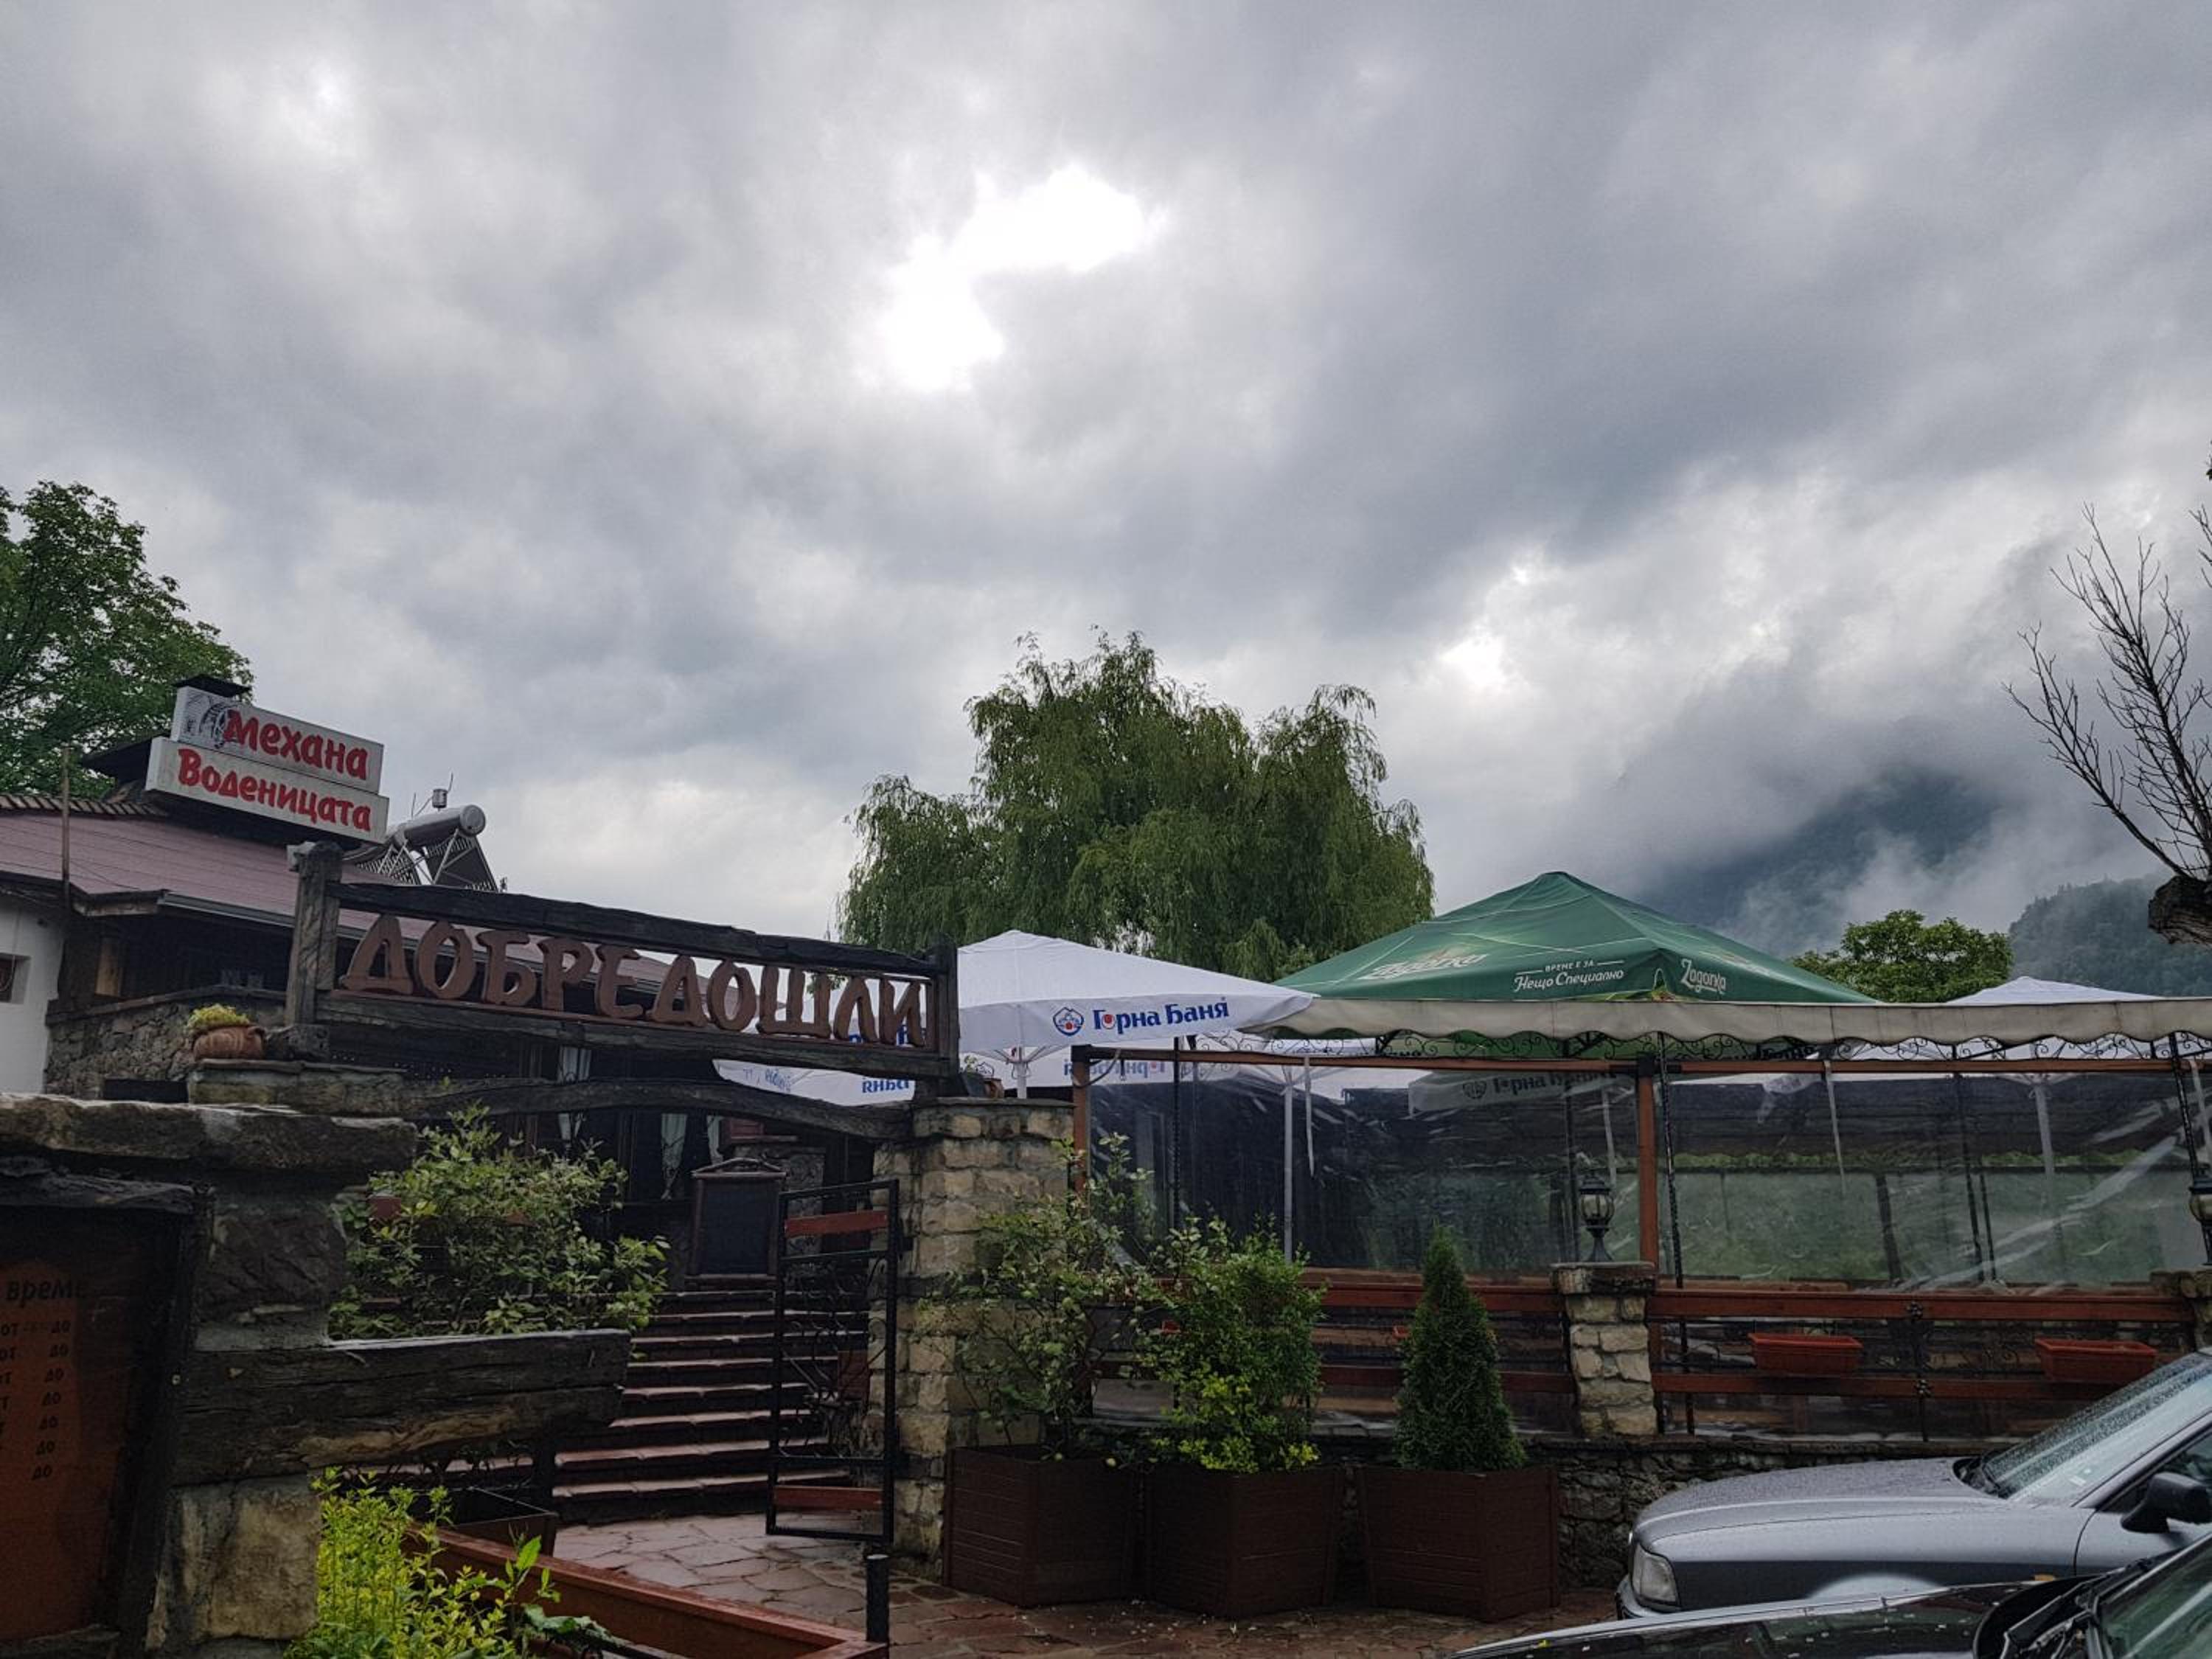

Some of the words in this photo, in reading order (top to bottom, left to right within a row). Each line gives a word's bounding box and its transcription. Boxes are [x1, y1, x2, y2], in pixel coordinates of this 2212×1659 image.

[224, 709, 368, 780] Механа
[177, 748, 371, 832] Воденицата
[1513, 975, 1554, 993] Нещо
[1555, 970, 1625, 986] Специално
[1680, 958, 1727, 994] Zagorka
[1092, 1009, 1161, 1034] Горна
[1165, 1001, 1230, 1024] Баня
